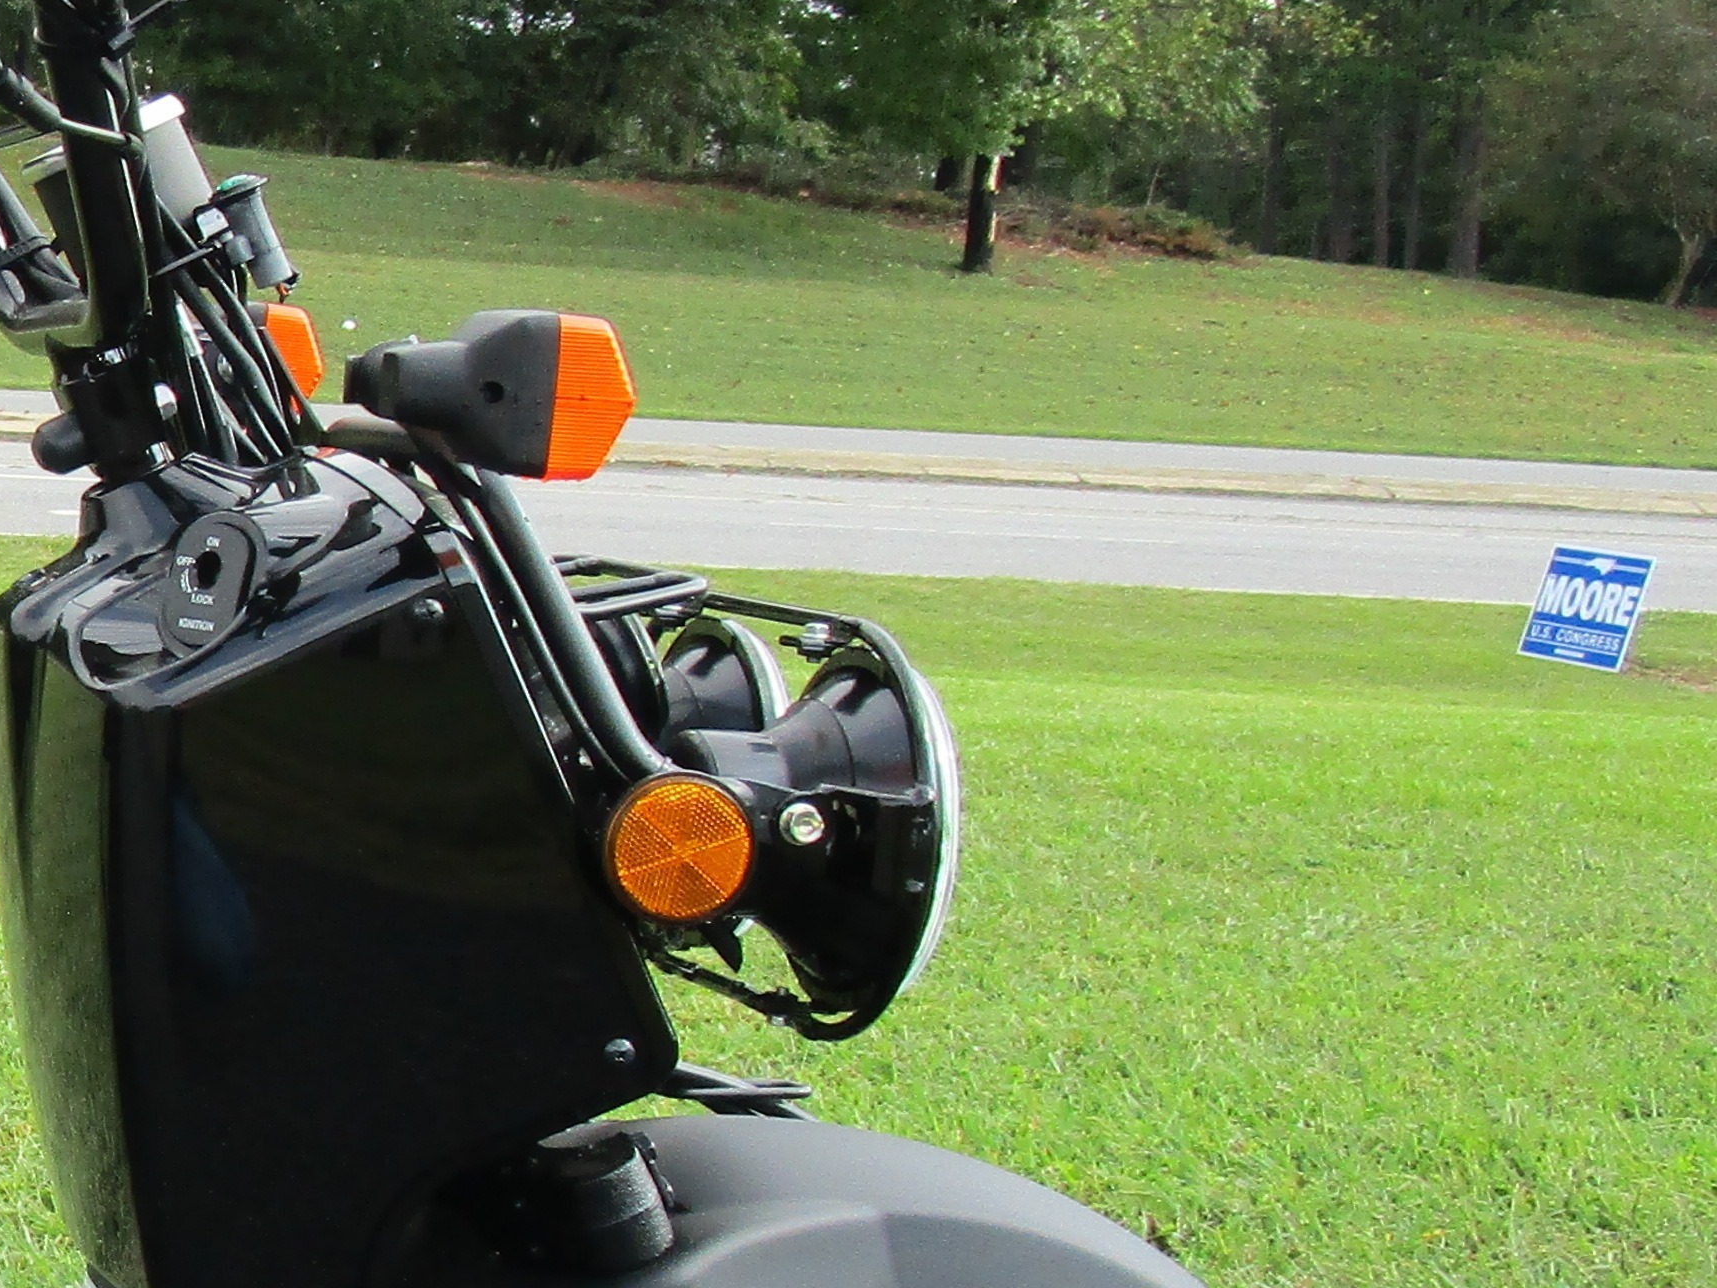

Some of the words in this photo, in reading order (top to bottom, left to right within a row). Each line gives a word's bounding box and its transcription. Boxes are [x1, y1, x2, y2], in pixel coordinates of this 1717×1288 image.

[206, 536, 221, 547] ON
[176, 555, 193, 565] OFF
[191, 594, 215, 606] LOCK
[1538, 575, 1640, 626] MOORE
[178, 618, 215, 631] IGNITION
[1531, 624, 1552, 639] U.S.
[1556, 630, 1620, 650] CONGRESS
